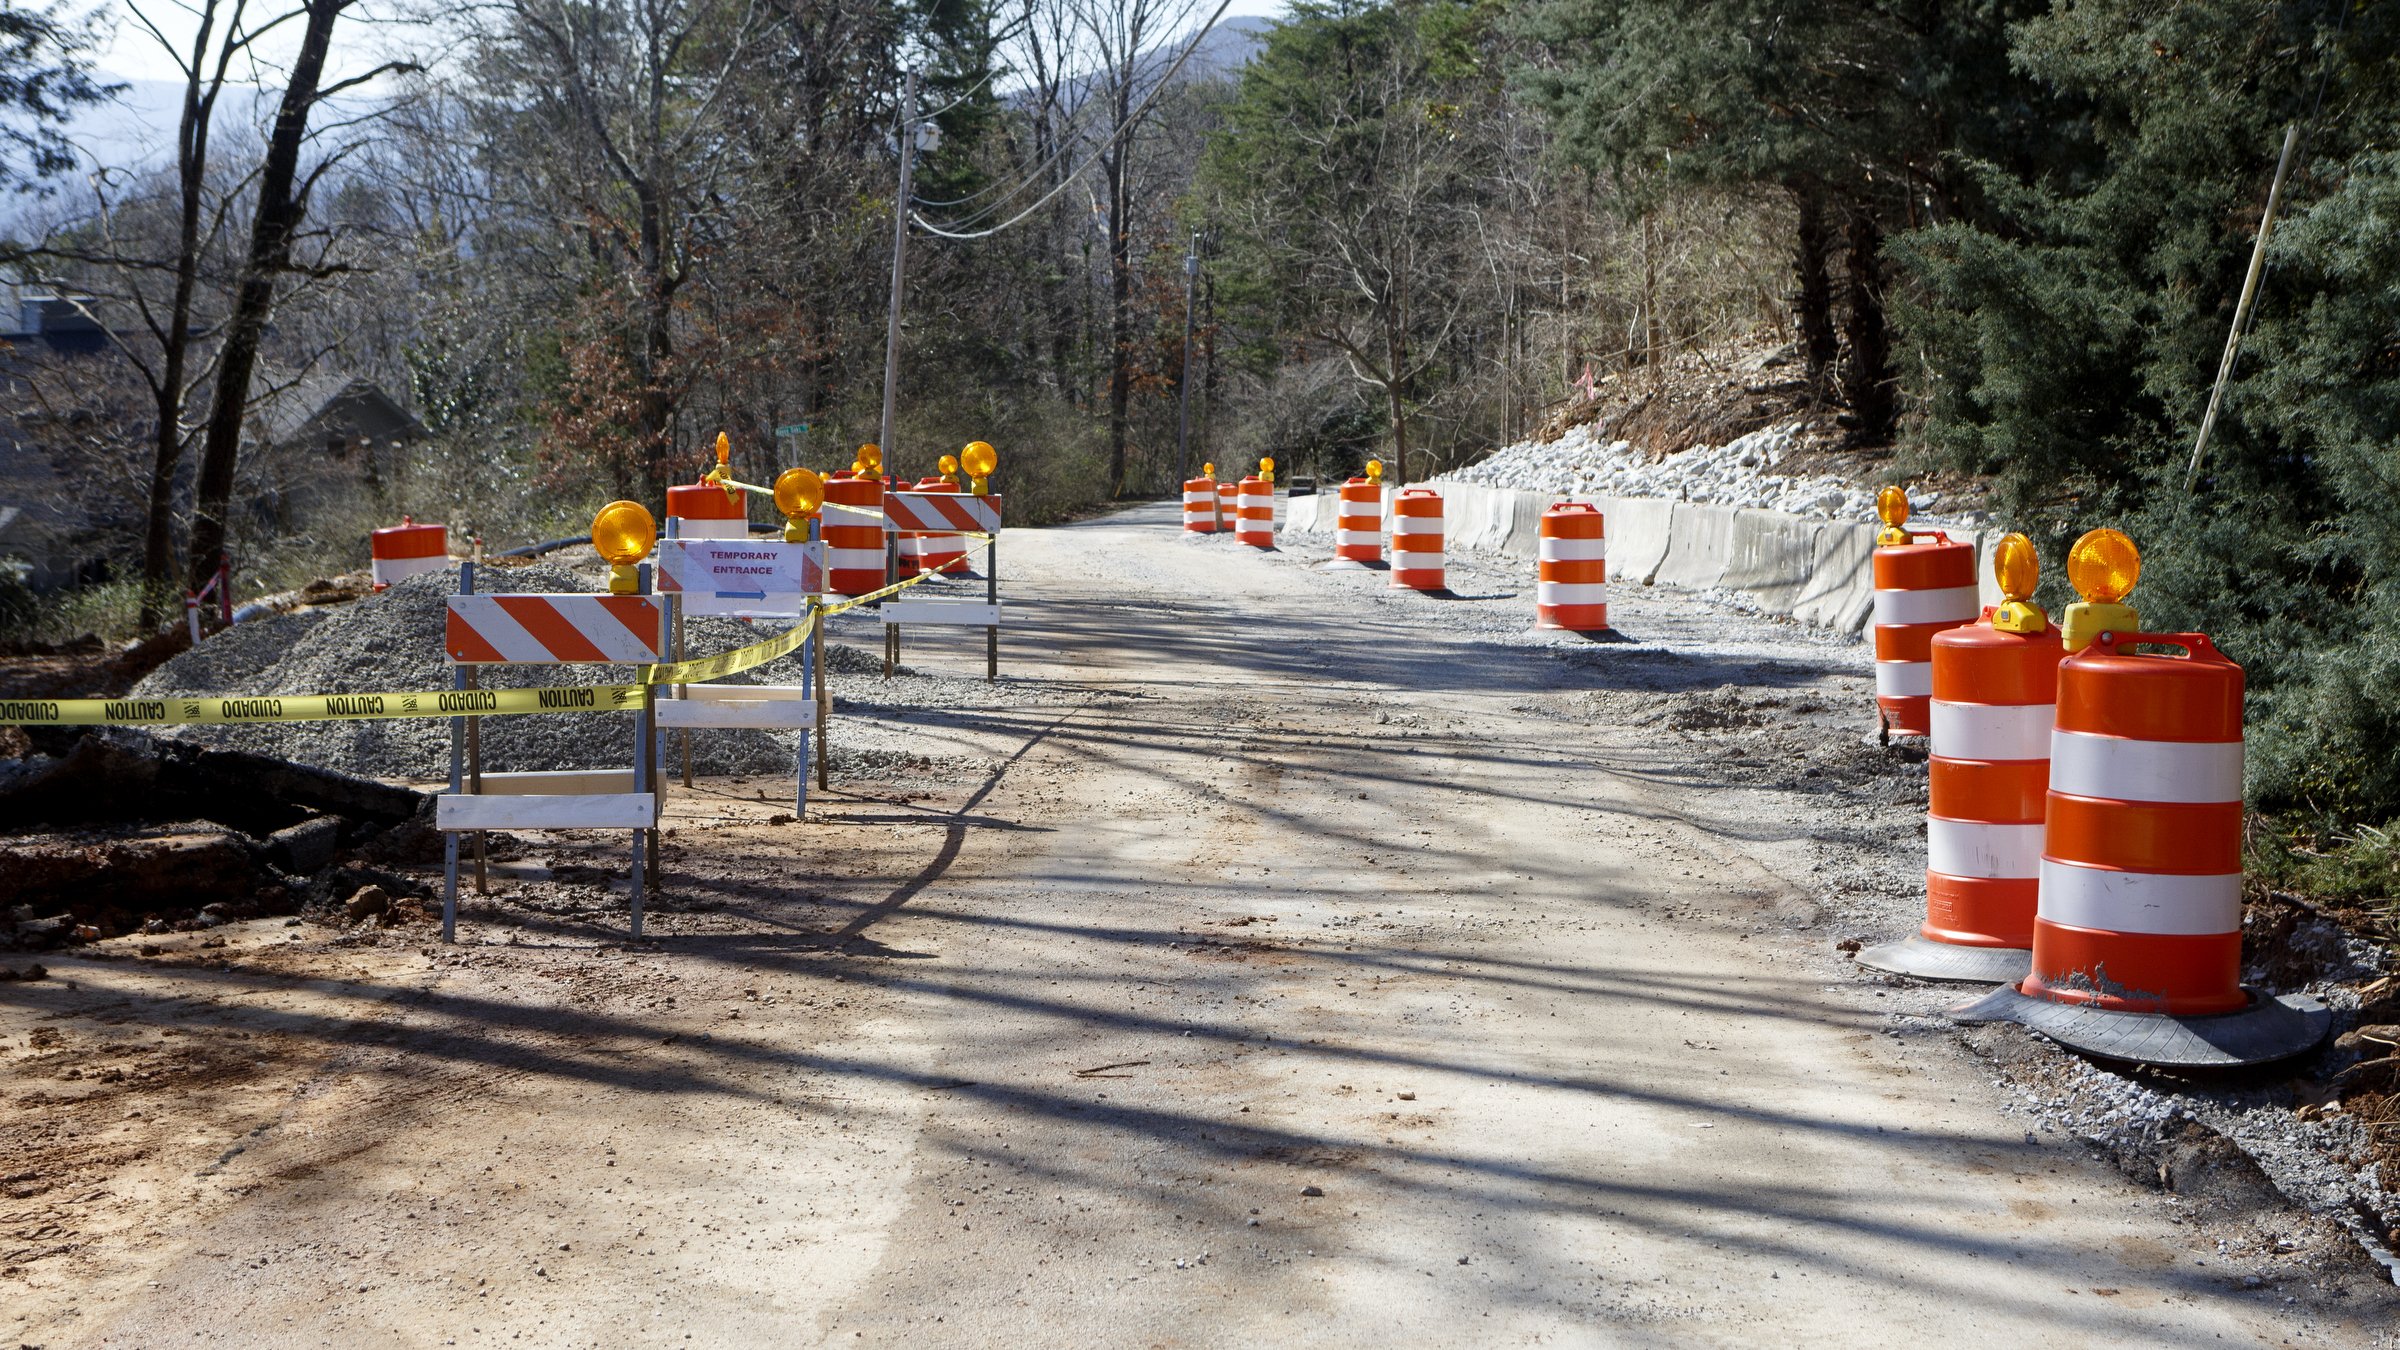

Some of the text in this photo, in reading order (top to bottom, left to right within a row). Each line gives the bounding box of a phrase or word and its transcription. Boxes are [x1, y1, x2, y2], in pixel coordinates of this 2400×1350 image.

[710, 551, 778, 560] TEMPORARY
[713, 566, 773, 575] ENTRANCE
[326, 696, 385, 715] CAUTION
[438, 692, 497, 711] CUIDADO
[538, 688, 595, 708] CAUTION
[104, 702, 166, 720] CAUTION
[221, 700, 283, 718] CUIDADO
